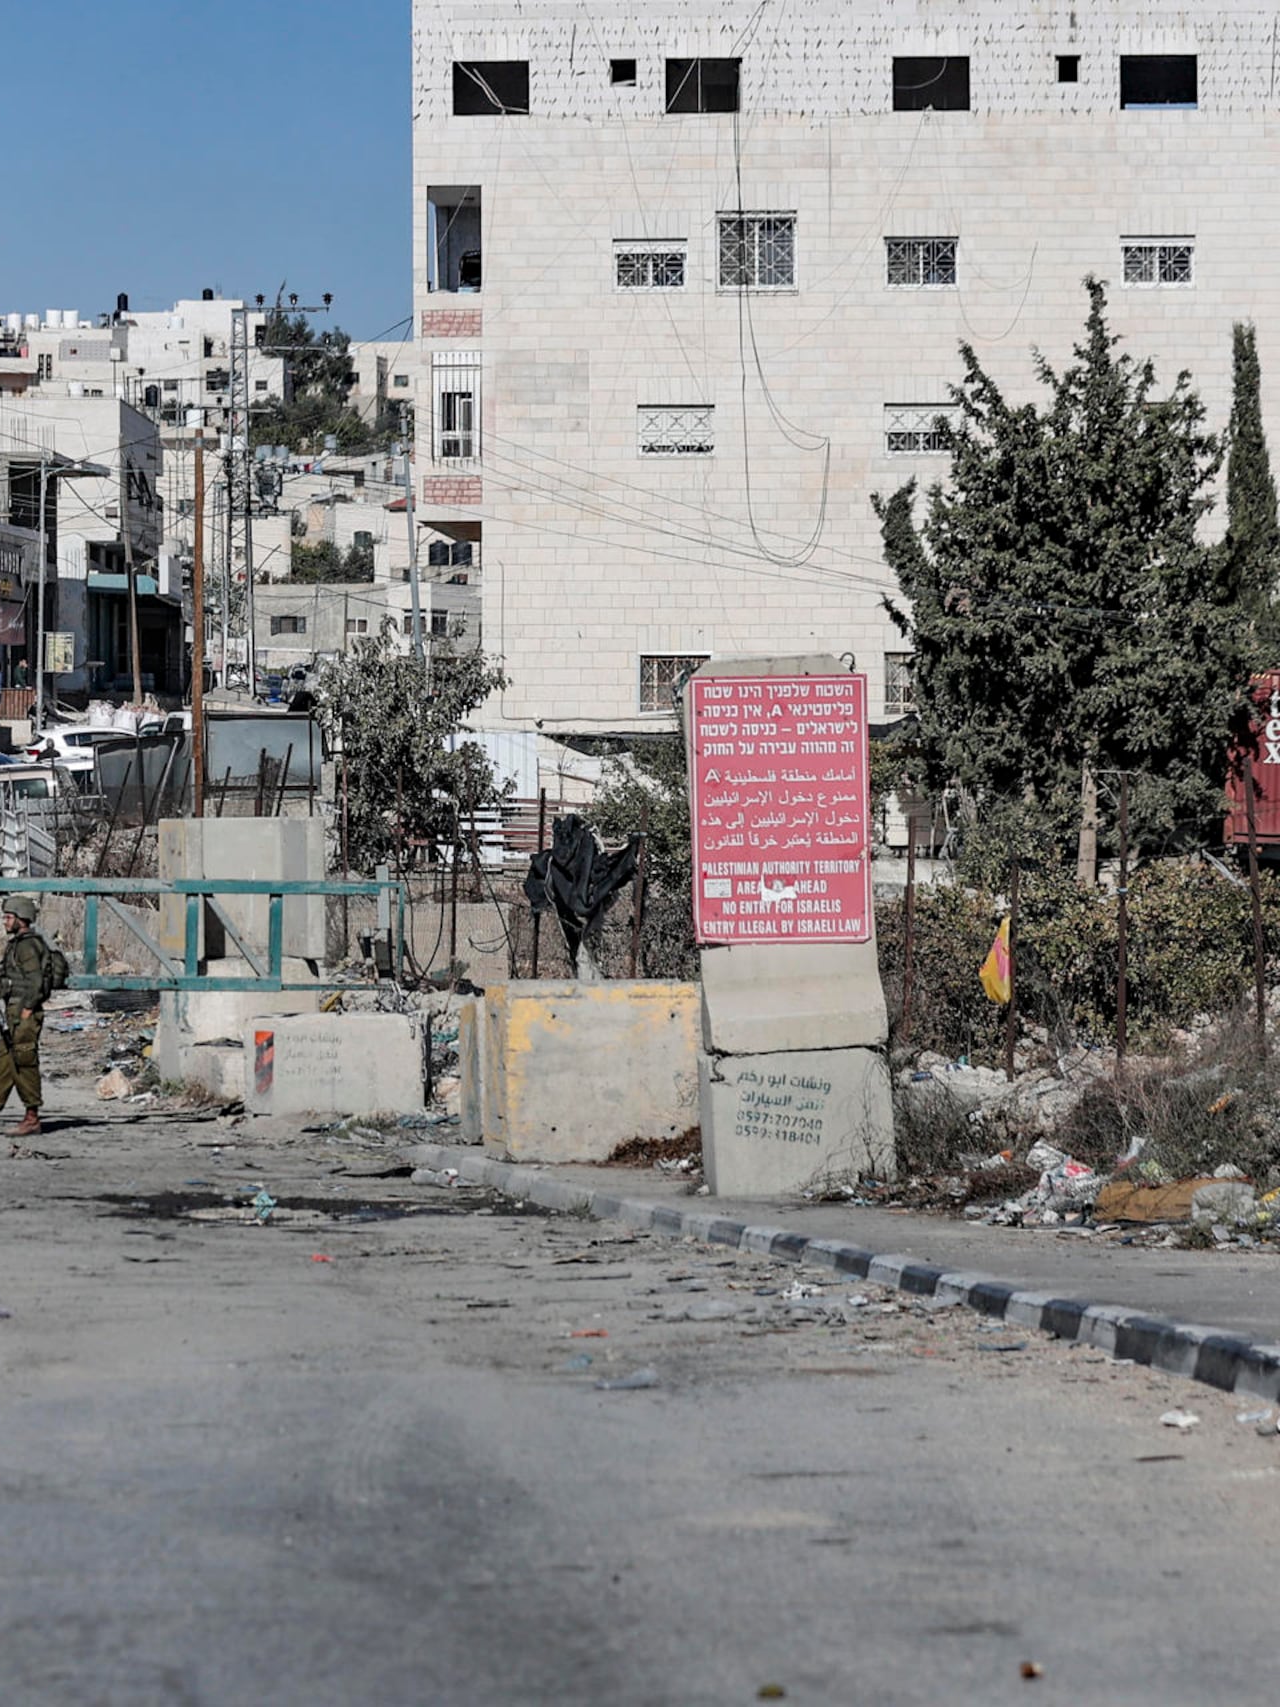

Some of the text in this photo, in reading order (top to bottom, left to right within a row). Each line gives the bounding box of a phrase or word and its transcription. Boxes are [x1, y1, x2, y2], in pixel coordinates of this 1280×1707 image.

[704, 683, 853, 700] השטח שלפניך הינו שטח
[703, 705, 739, 718] כניסה
[743, 704, 762, 719] אין
[700, 721, 738, 737] לשטח
[742, 722, 777, 735] כניסה
[796, 720, 858, 735] לישראלים
[703, 740, 854, 758] זה מהווה עבירה על החוק
[704, 766, 856, 787] أمامك منطقة فلسطينية A
[778, 789, 813, 805] دخول
[817, 792, 857, 808] ممنوع
[701, 814, 722, 826] هذه
[725, 811, 745, 830] إلى
[825, 811, 860, 826] دخول
[704, 833, 744, 850] للقانون
[816, 831, 858, 846] المنطقة
[702, 859, 861, 876] PALESTINIAN AUTHORITY TERRITORY
[793, 879, 827, 894] AHEAD
[722, 898, 842, 915] NO ENTRY FOR ISRAELIS
[704, 918, 861, 934] ENTRY ILLEGAL BY ISRAELI LAW
